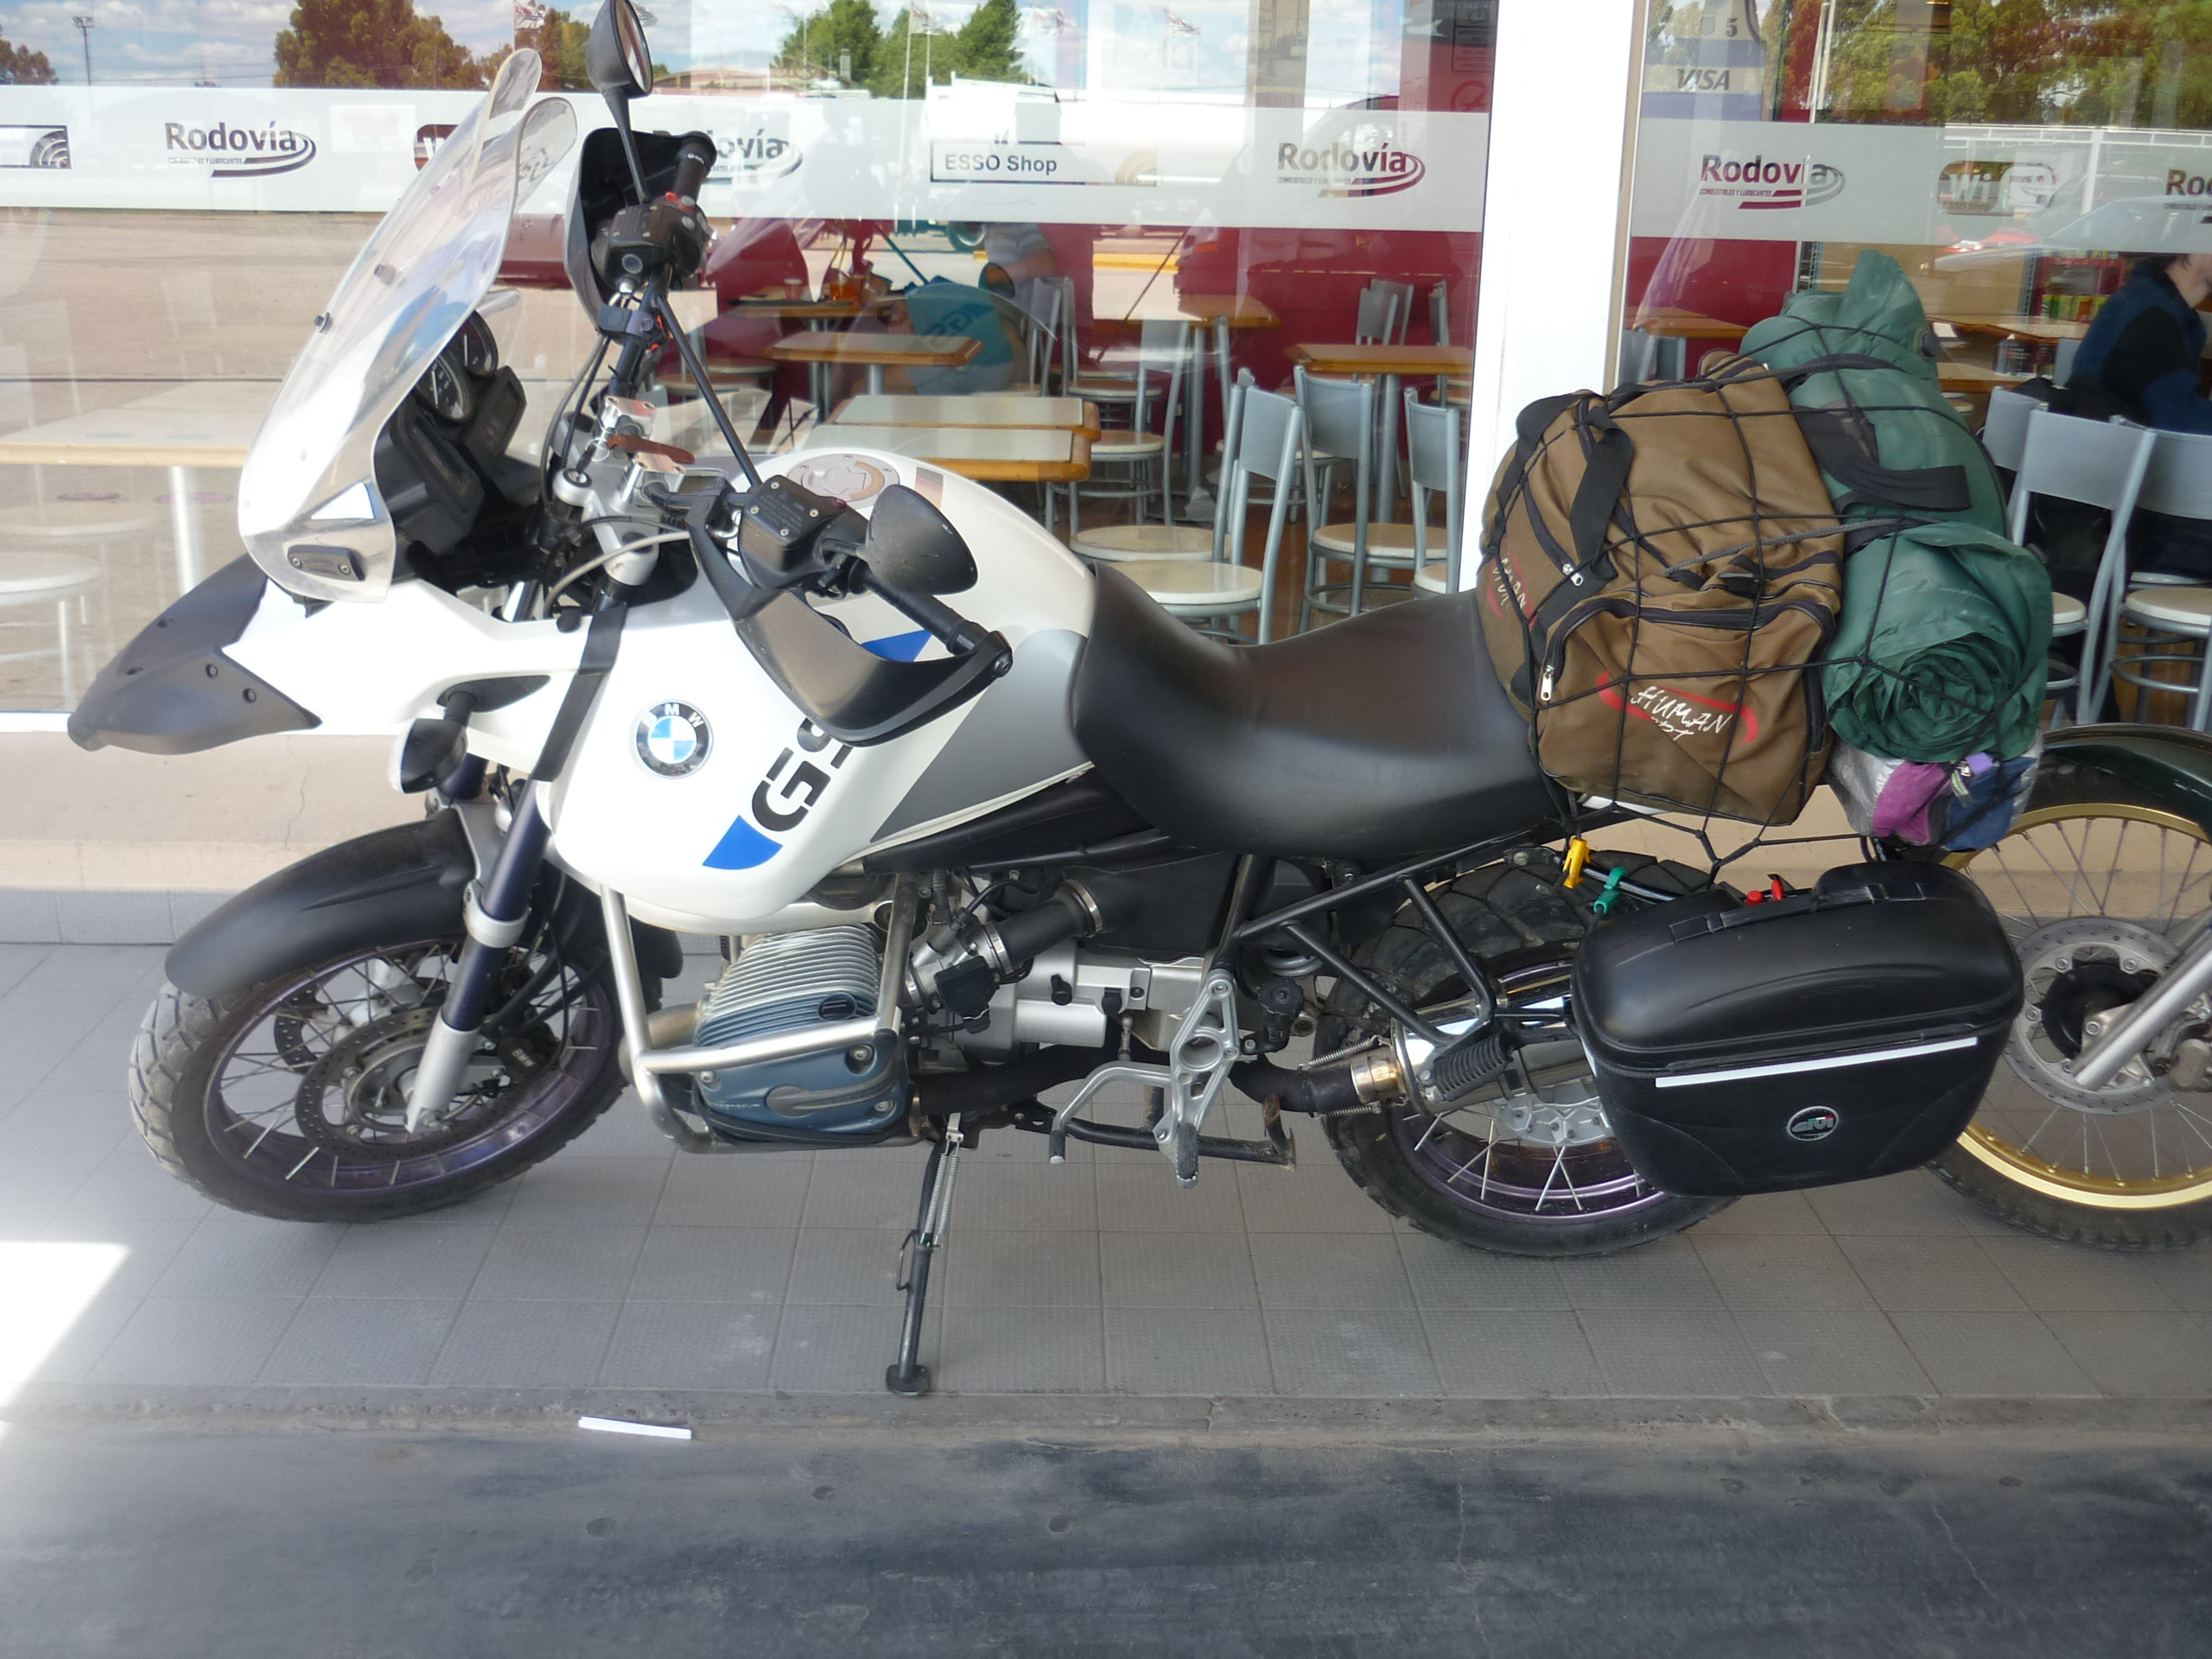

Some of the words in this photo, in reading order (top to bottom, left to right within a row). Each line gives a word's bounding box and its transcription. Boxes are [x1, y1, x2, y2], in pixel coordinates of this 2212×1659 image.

[1676, 68, 1730, 91] VISA
[164, 120, 297, 151] Rodovía
[944, 154, 1000, 171] ESSO
[1007, 155, 1058, 175] Shop
[1277, 142, 1407, 173] Rodovía
[1700, 154, 1828, 185] Rodovía
[1699, 188, 1735, 196] COMBUSTIBLES
[1739, 188, 1773, 198] LUBRICANTES
[641, 702, 704, 728] BMW
[1630, 686, 1732, 734] HUMAN
